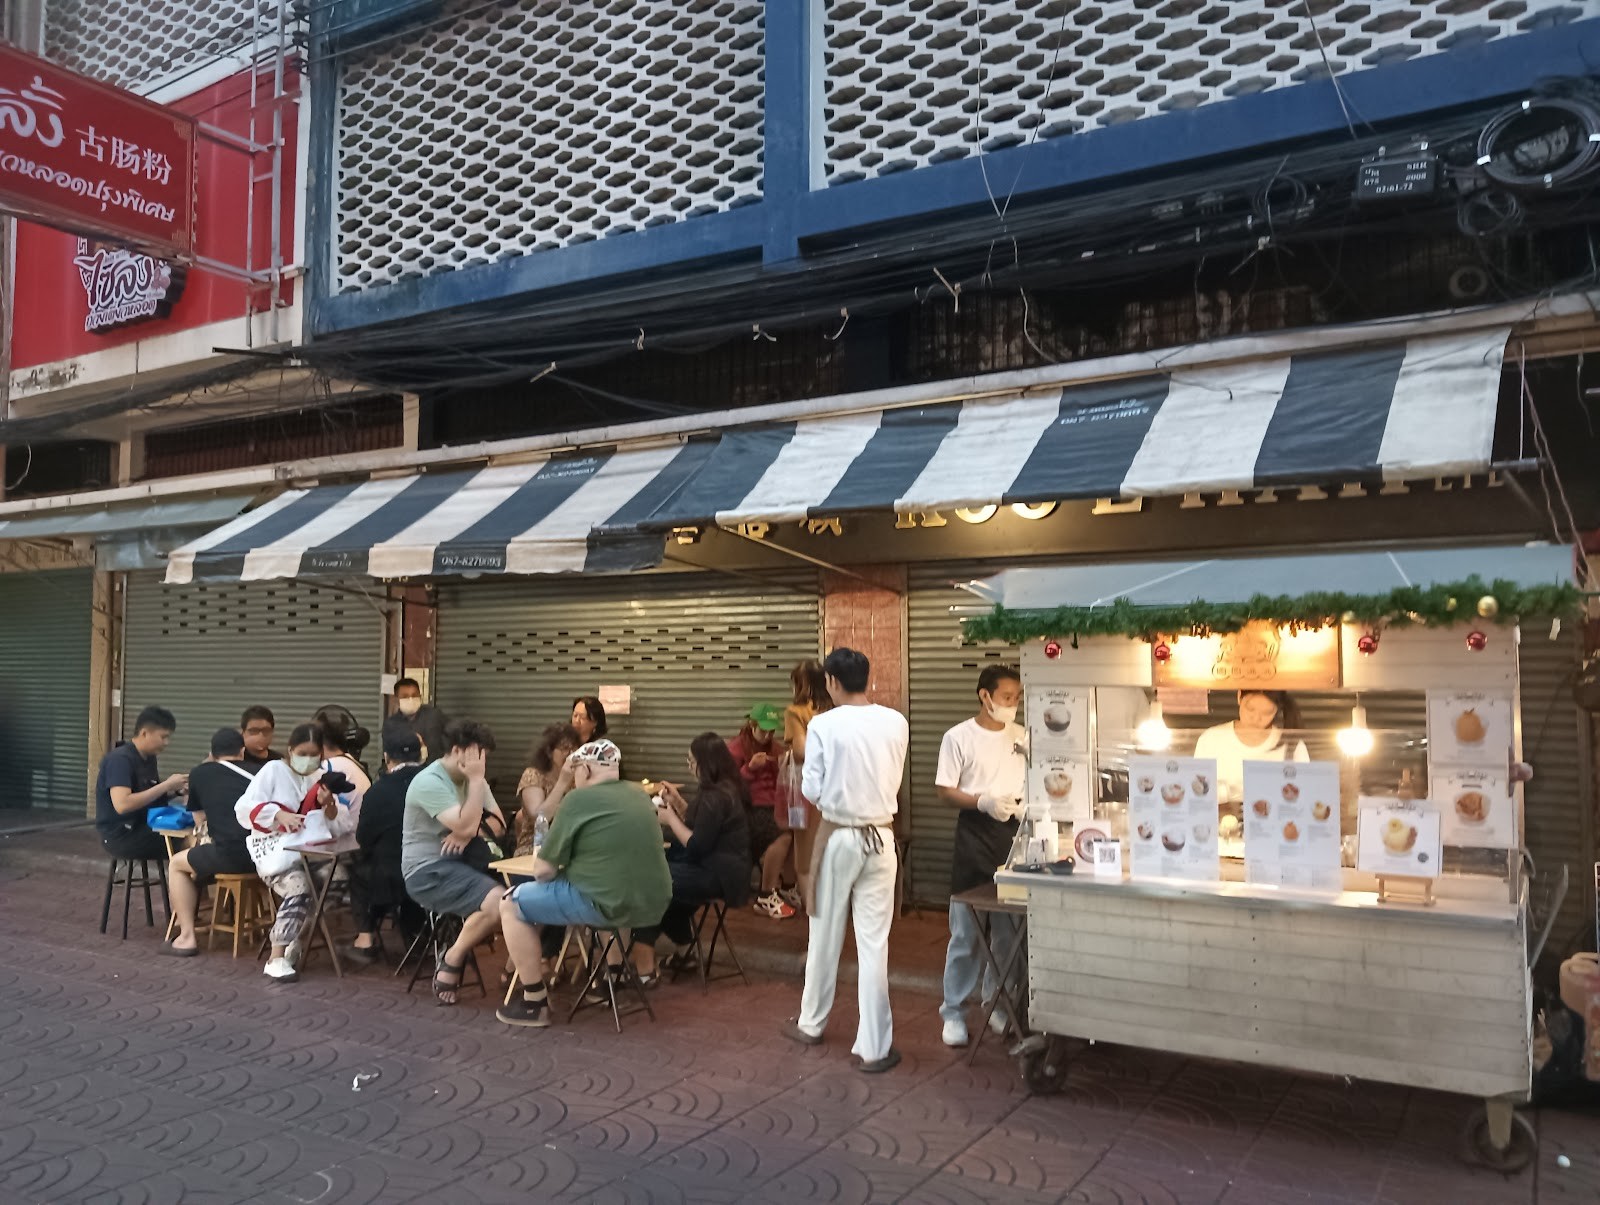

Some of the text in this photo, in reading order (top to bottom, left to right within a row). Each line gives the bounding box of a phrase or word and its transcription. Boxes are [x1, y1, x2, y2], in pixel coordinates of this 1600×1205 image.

[0, 150, 176, 223] วหลอดปรุงพิเศษ
[75, 125, 173, 186] 古肠粉
